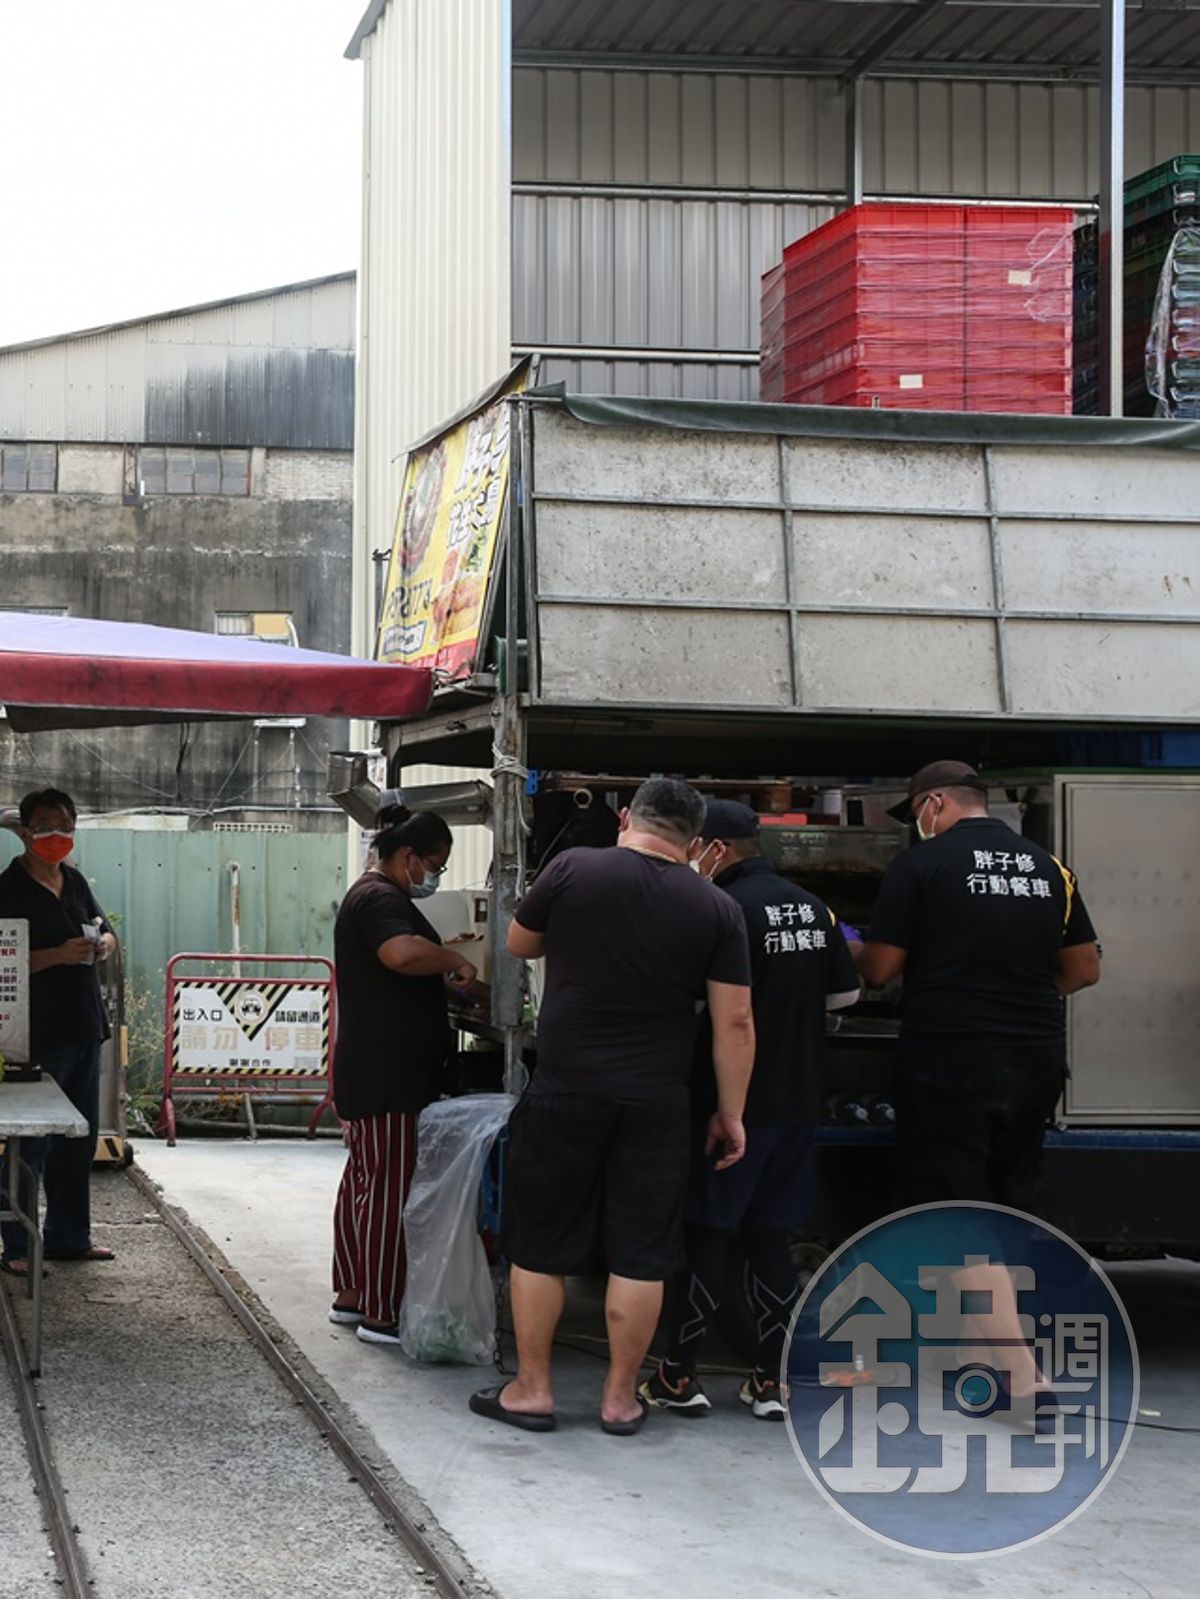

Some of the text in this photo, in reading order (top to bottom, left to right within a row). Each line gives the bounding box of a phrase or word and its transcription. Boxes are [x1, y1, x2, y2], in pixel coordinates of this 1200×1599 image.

[973, 850, 1036, 873] 胖子修
[966, 873, 1051, 899] 行動餐車
[764, 903, 816, 926] 胖子修
[764, 929, 827, 954] 行動餐車
[183, 1008, 223, 1022] 出入口
